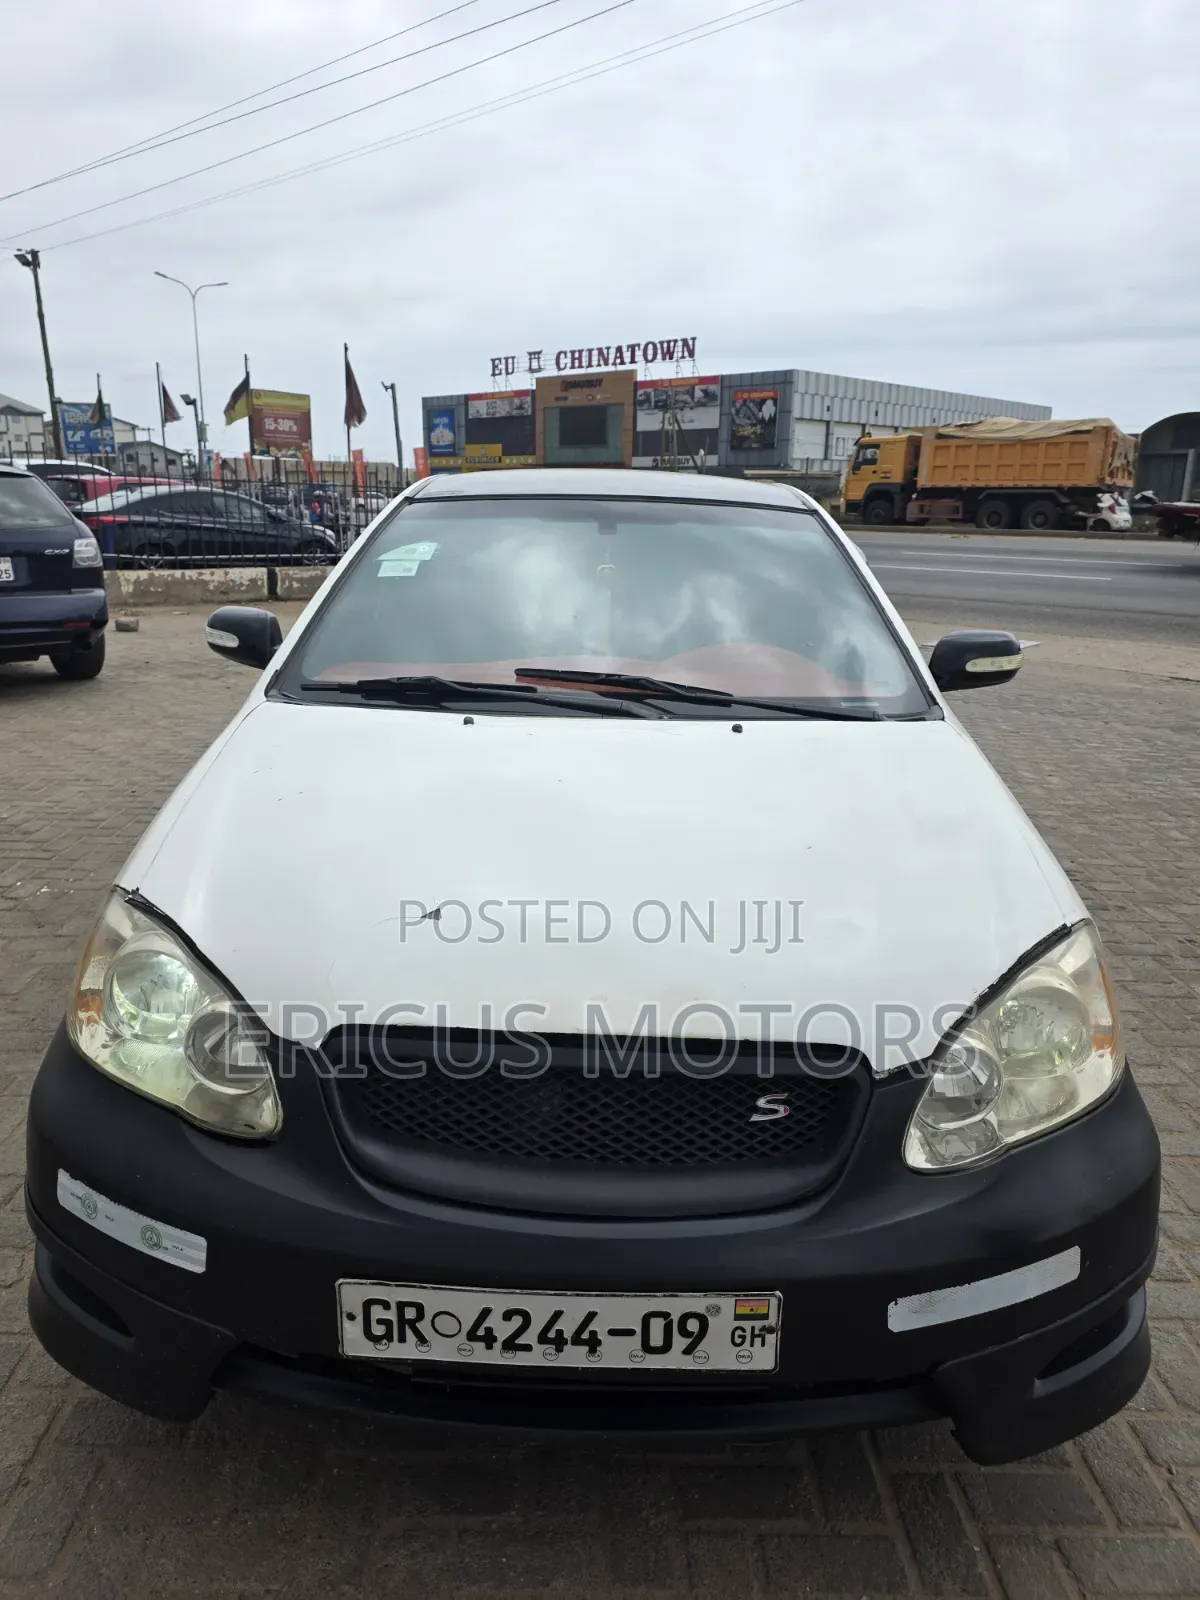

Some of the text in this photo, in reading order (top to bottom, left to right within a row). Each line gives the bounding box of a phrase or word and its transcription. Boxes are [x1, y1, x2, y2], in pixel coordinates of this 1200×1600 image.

[490, 336, 697, 377] EU CHINATOWN
[749, 1092, 790, 1122] S
[362, 1297, 710, 1356] GR 4244-09
[730, 1325, 766, 1348] GH
